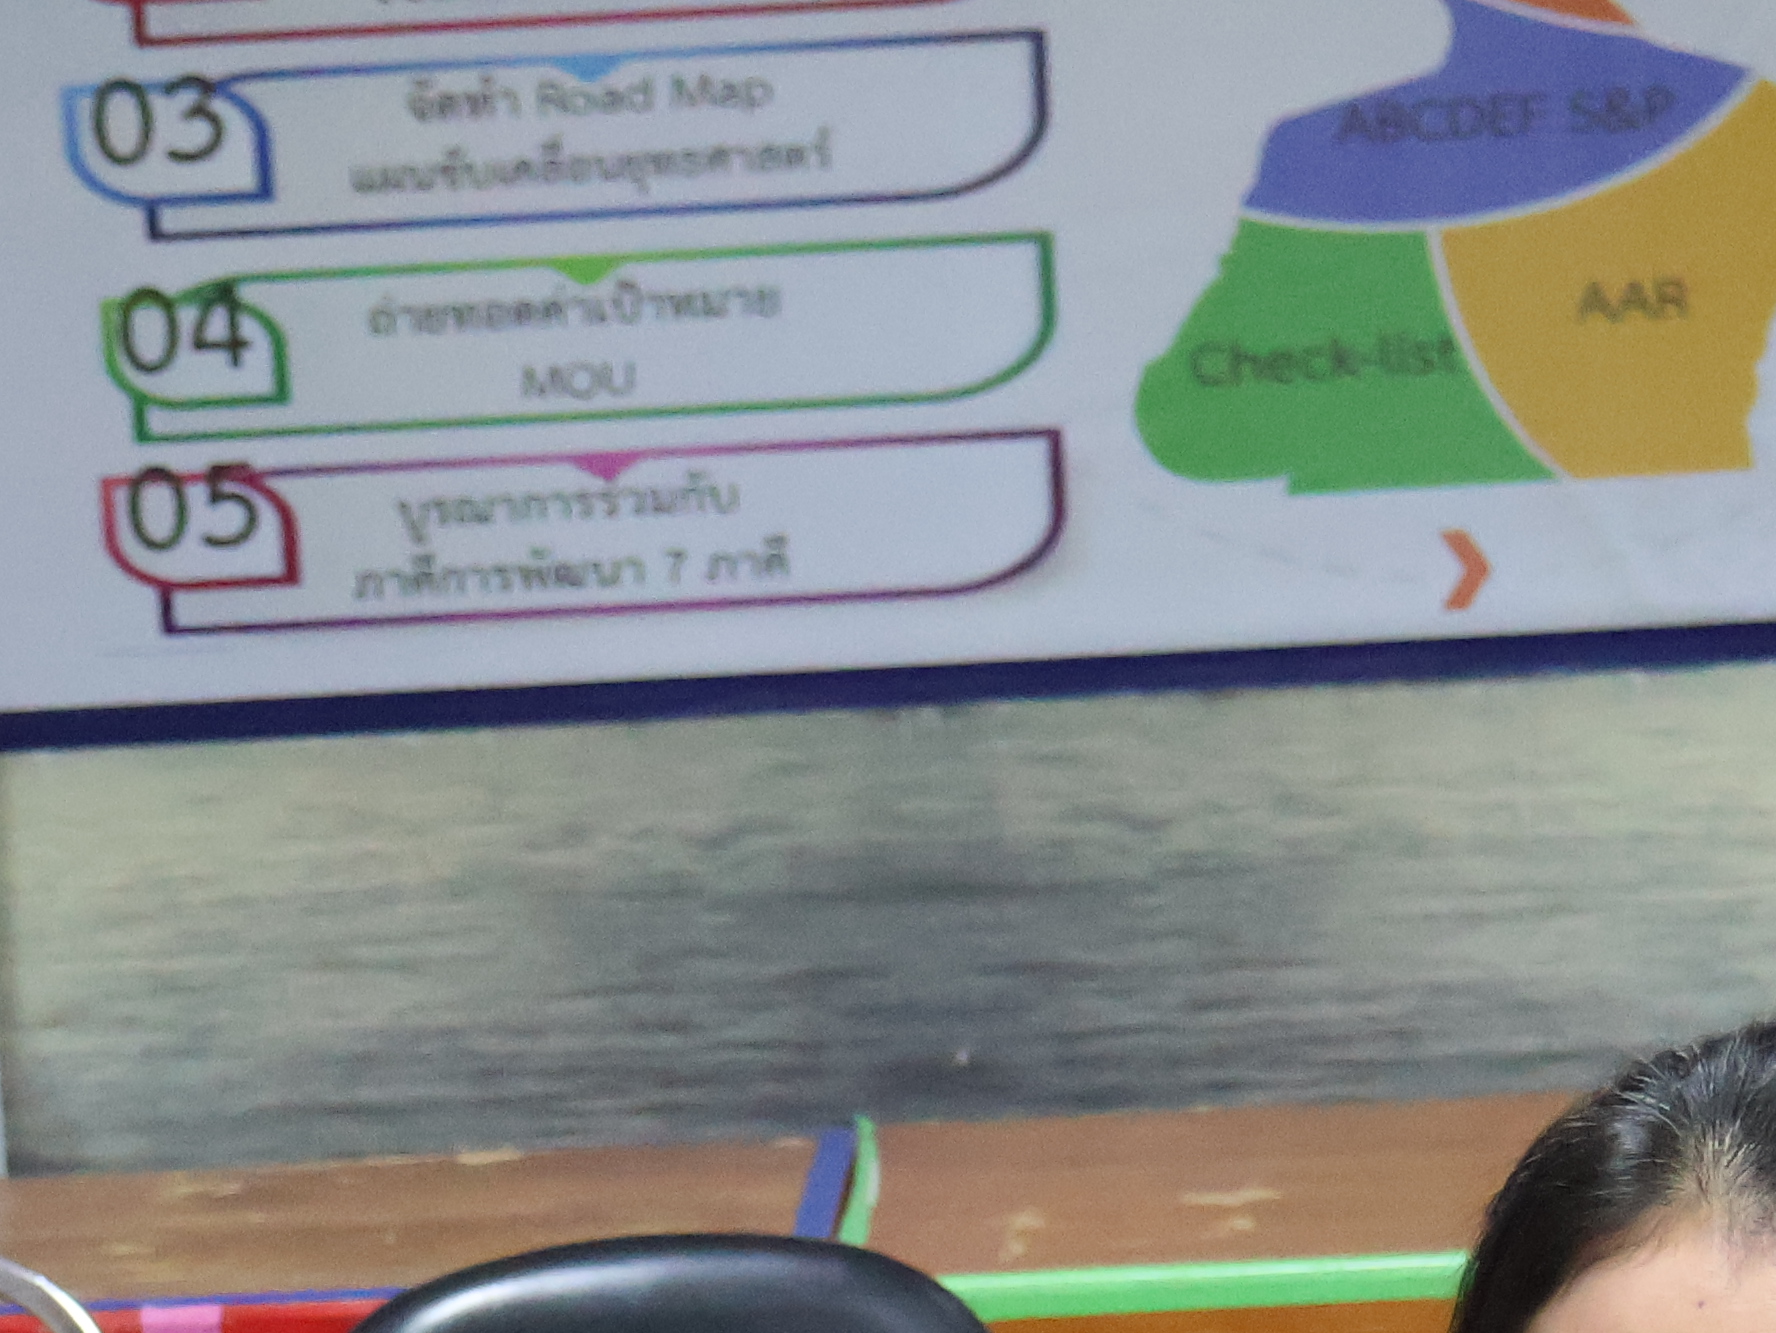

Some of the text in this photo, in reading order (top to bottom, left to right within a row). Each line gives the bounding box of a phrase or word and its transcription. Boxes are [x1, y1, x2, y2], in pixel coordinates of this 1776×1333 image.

[92, 76, 227, 165] 03
[535, 71, 656, 117] Road
[668, 73, 774, 111] Map
[1336, 83, 1676, 146] ABCDEF S&P
[118, 279, 255, 374] 04
[1578, 279, 1691, 324] AAR
[520, 361, 637, 402] MOU
[1187, 329, 1457, 389] Check-list
[128, 463, 261, 552] 05
[664, 547, 690, 581] 7
[706, 533, 791, 582] ภาคี
